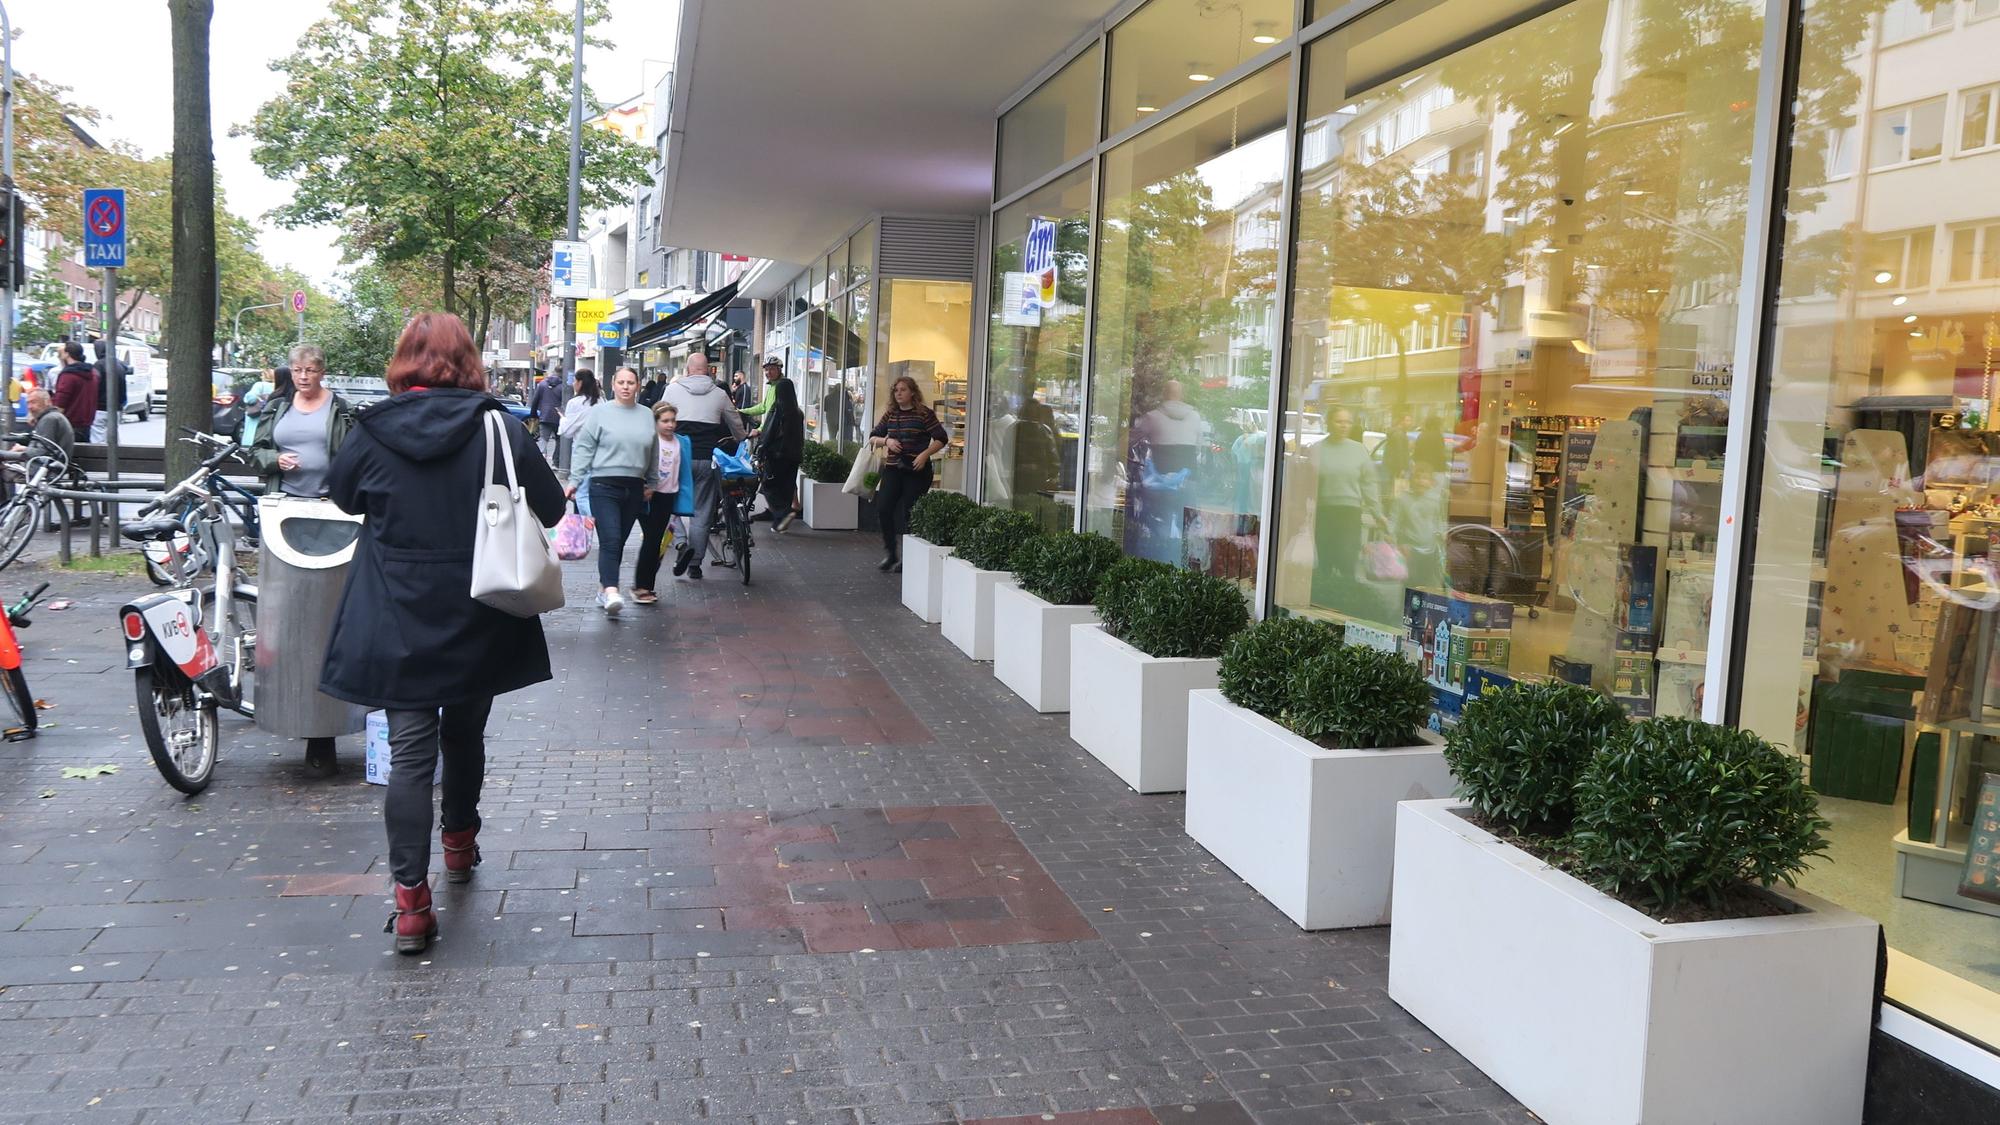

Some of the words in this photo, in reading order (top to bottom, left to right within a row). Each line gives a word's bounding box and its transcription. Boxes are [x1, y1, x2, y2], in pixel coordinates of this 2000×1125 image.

[88, 243, 122, 260] TAXI
[1025, 219, 1055, 273] dm
[576, 310, 605, 319] TAKKO
[1696, 361, 1718, 372] Nur
[1692, 374, 1718, 386] Dich
[1570, 437, 1592, 445] share
[161, 619, 179, 639] KVB
